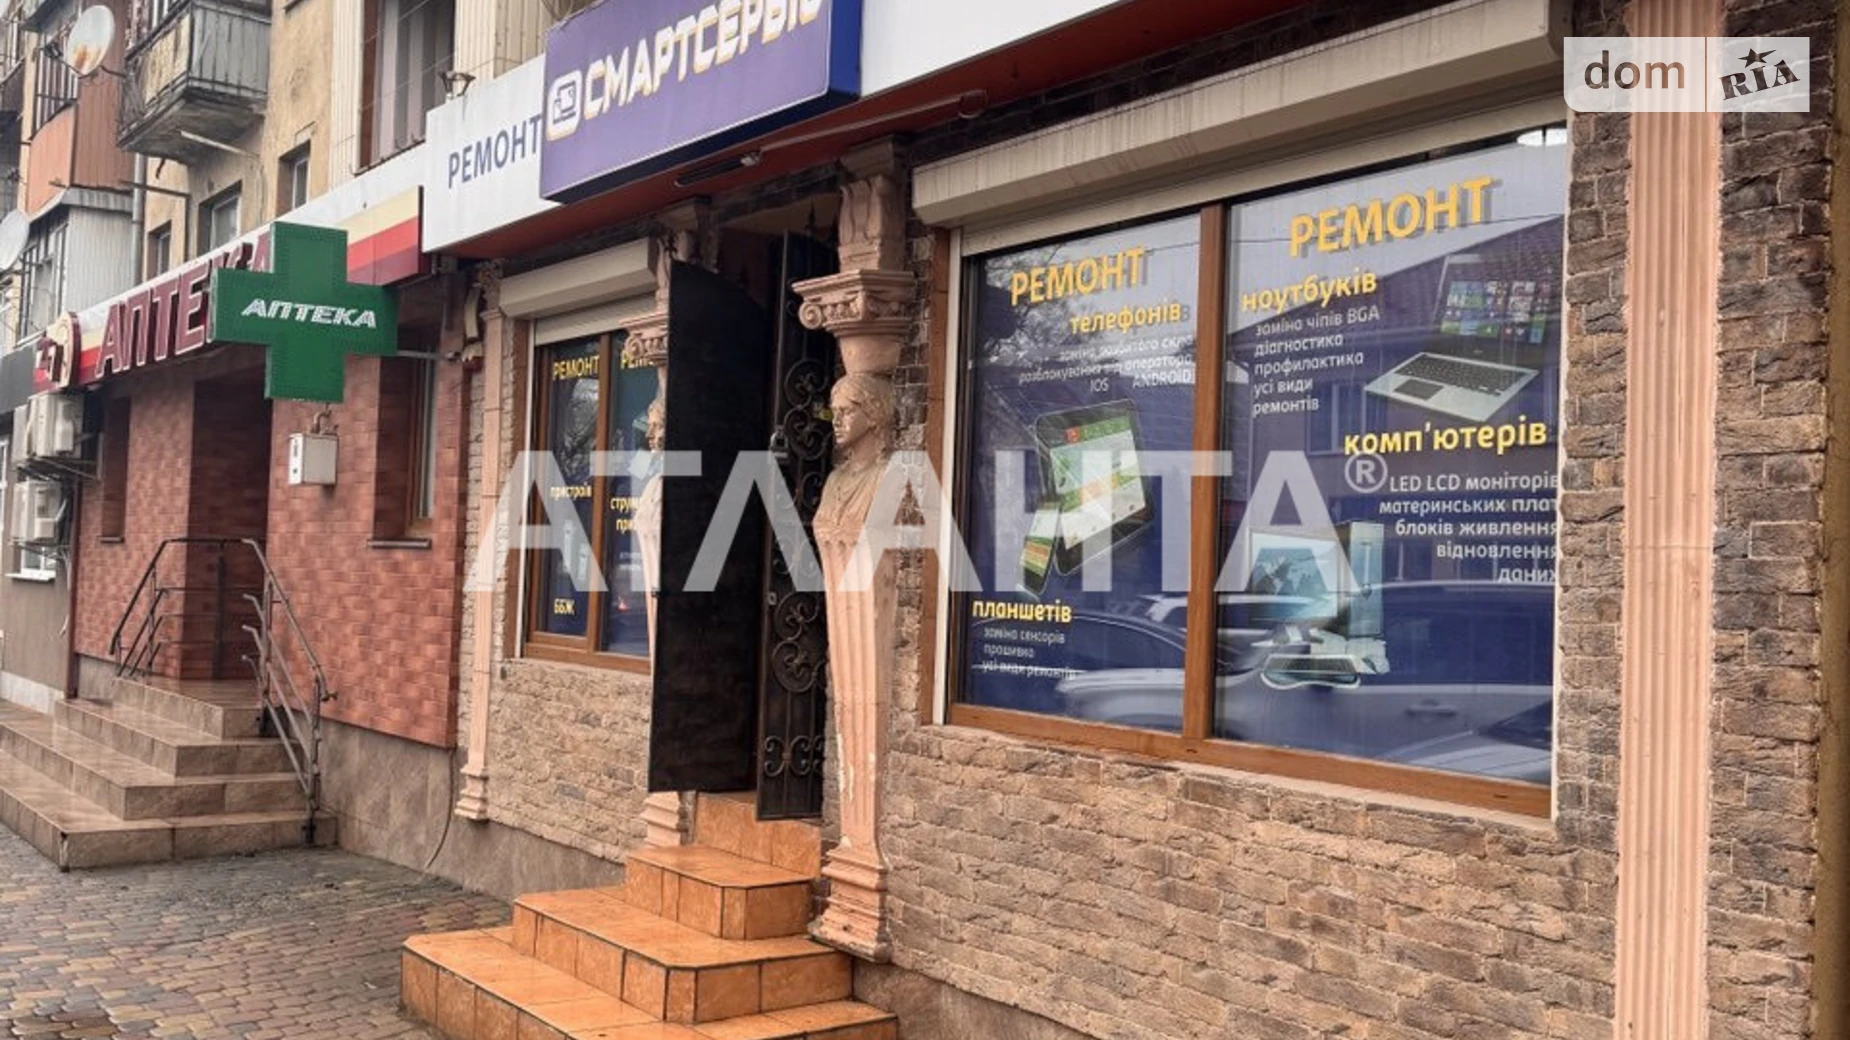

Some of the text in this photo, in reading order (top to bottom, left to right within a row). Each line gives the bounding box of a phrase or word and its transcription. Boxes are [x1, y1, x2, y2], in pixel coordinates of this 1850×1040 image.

[448, 113, 541, 188] РЕМОНТ
[1289, 174, 1494, 258] РЕМОНТ
[1010, 246, 1147, 306] РЕМОНТ
[95, 231, 271, 378] АПТЕ
[1241, 269, 1378, 314] ноутбуків
[241, 298, 377, 329] АПТЕКА
[1069, 301, 1183, 334] телефонів
[1254, 304, 1381, 337] заміна чіпів BGA
[1254, 333, 1344, 358] діагностика
[552, 354, 600, 381] РЕМОНТ
[1254, 351, 1364, 378] профилактика
[1253, 378, 1313, 399] усі види
[1252, 395, 1320, 418] ремонтів
[1389, 471, 1558, 493] LED LCD моніторів
[1379, 499, 1506, 517] материнських
[1395, 519, 1557, 536] блоків живлення
[1436, 540, 1557, 560] відновлення
[972, 599, 1072, 624] планшетів
